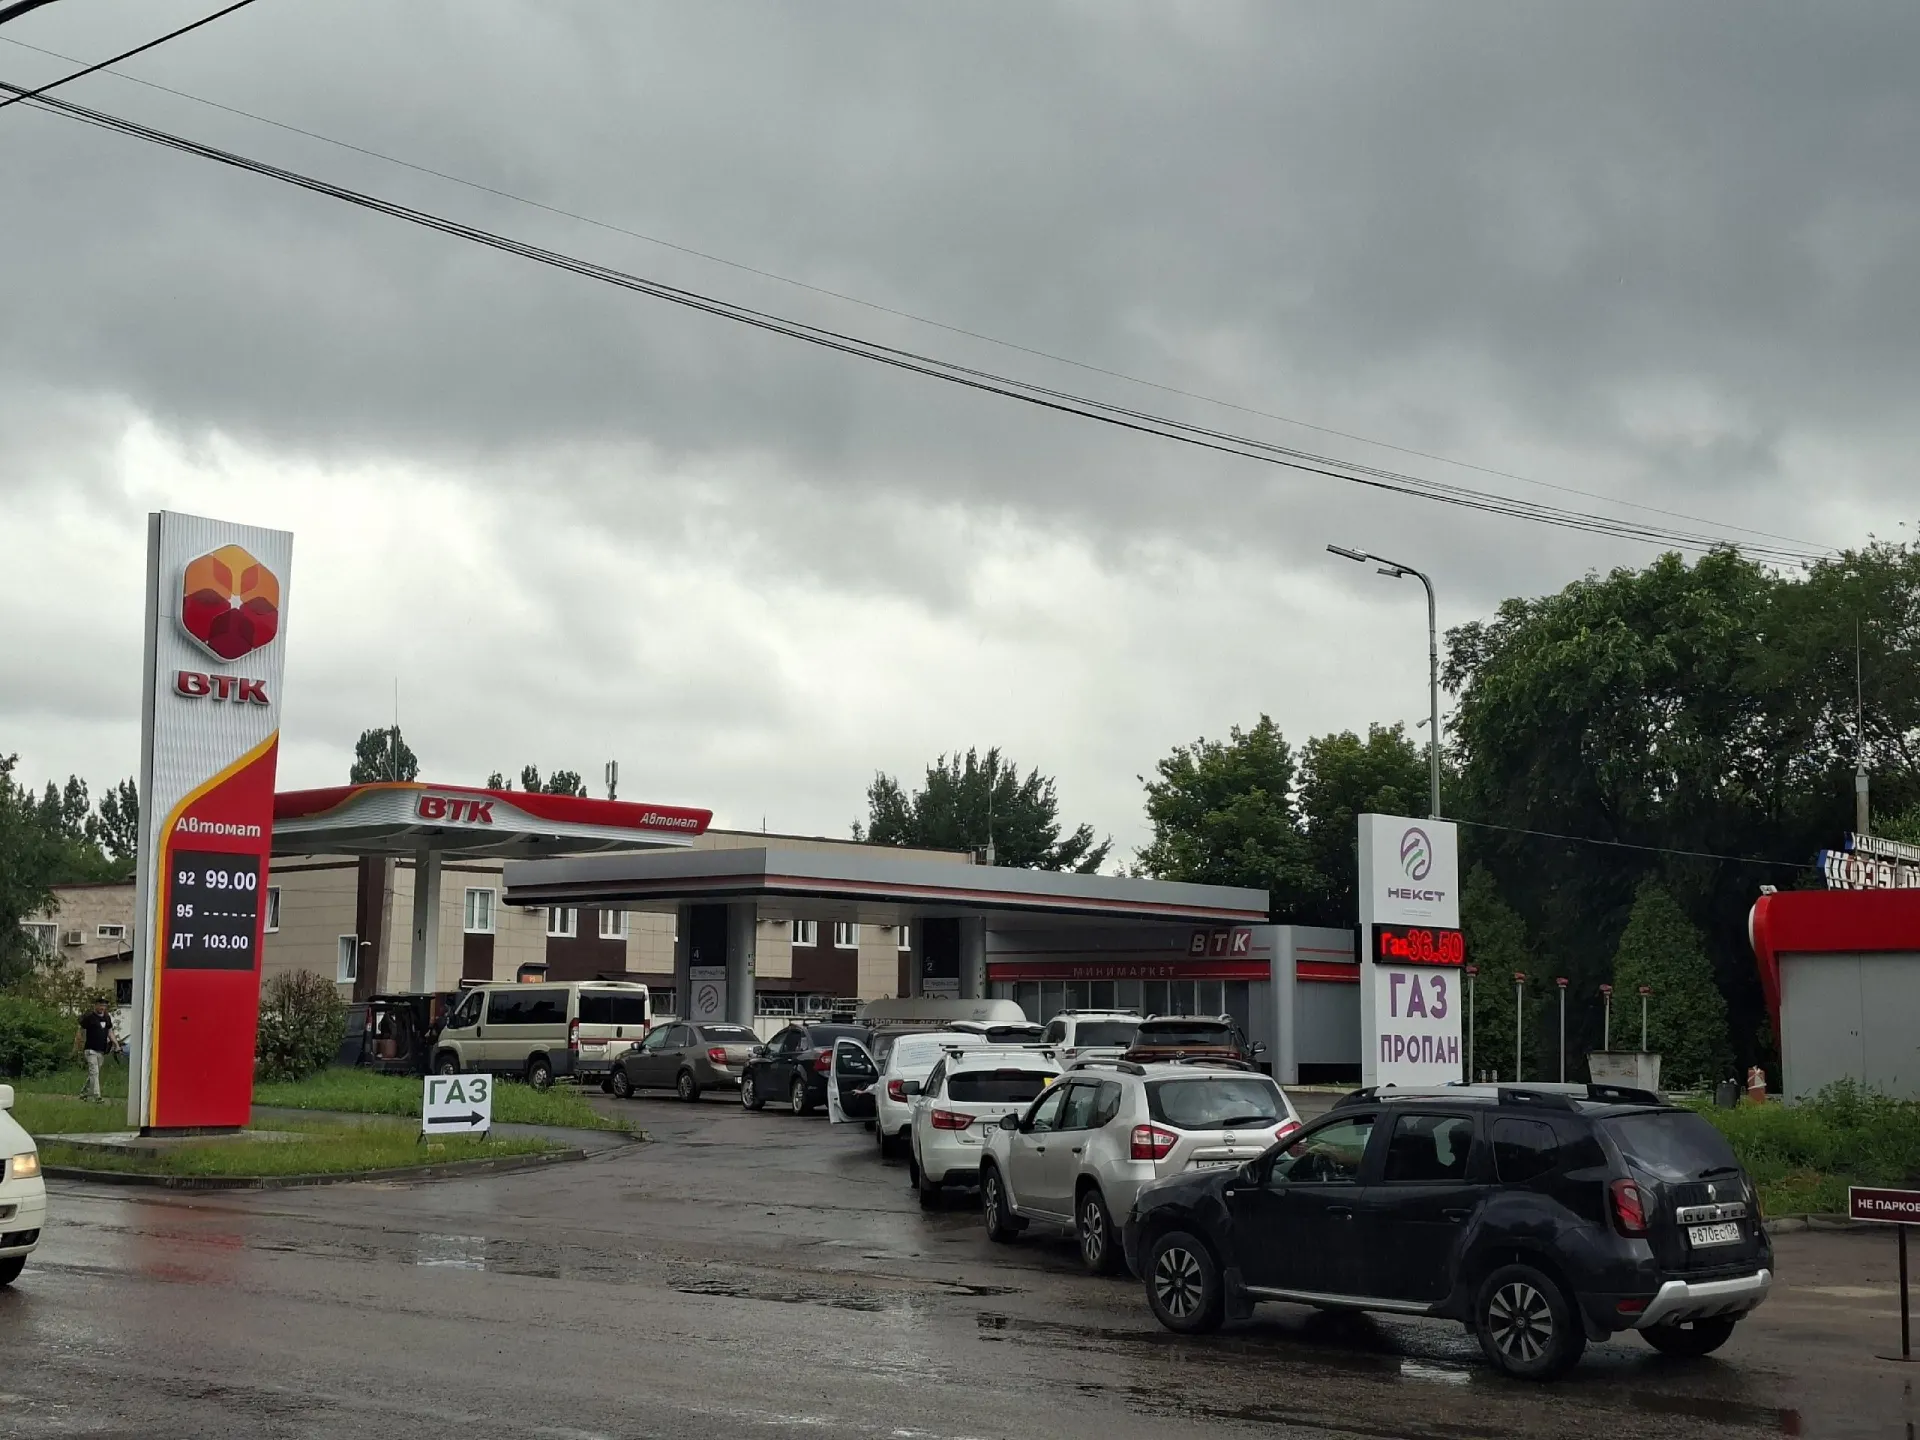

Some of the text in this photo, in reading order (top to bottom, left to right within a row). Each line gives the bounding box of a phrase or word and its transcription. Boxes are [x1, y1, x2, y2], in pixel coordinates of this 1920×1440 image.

[175, 670, 270, 705] ВТК
[418, 795, 495, 824] ВТК
[175, 817, 261, 838] Автомат
[640, 811, 698, 829] Автомат
[178, 870, 257, 890] 92 99.00
[1387, 887, 1445, 902] НЕКСТ
[176, 904, 193, 918] 95
[172, 933, 249, 950] ДТ 103.00
[417, 928, 422, 941] 1
[1191, 933, 1249, 952] ВТК
[1408, 929, 1464, 964] 36.50
[1073, 966, 1175, 977] МИНИМАРКЕТ
[1389, 972, 1448, 1019] ГАЗ
[1380, 1034, 1459, 1064] ПРОПАН
[429, 1078, 488, 1105] ГАЗ
[1858, 1199, 1873, 1209] НЕ
